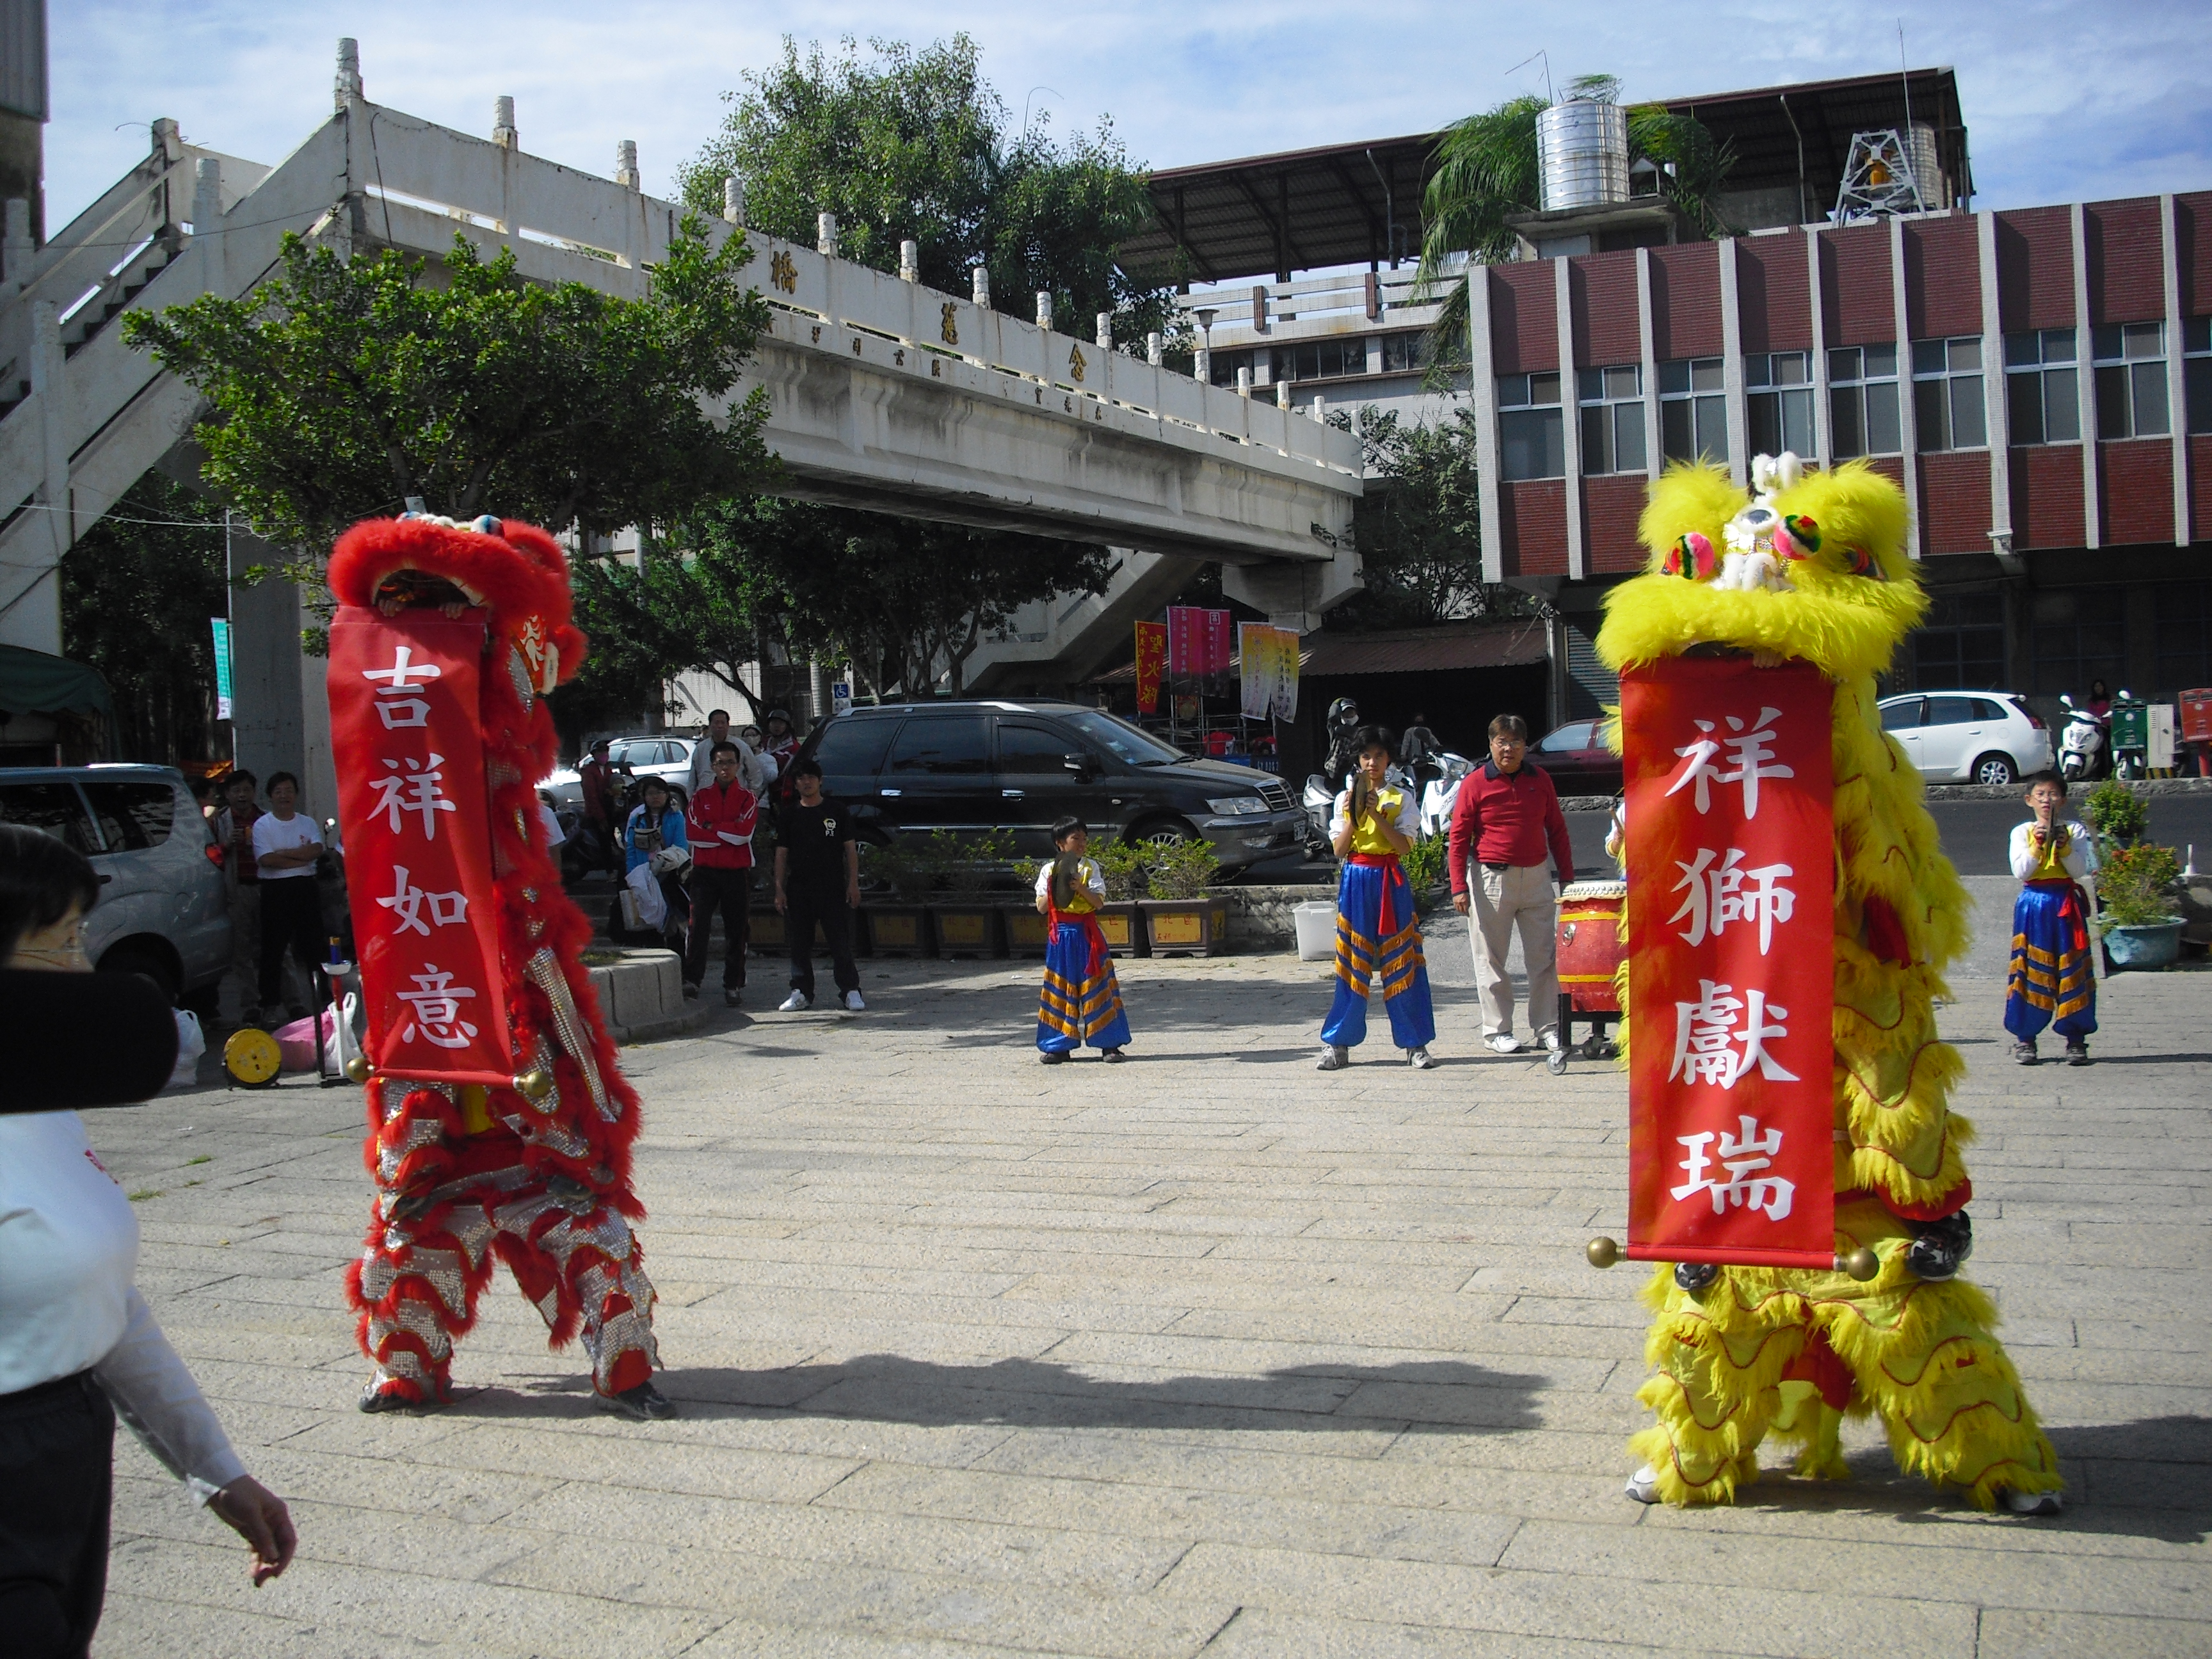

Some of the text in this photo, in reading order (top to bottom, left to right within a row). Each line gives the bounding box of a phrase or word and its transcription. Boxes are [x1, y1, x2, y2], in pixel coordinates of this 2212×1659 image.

[362, 646, 477, 1048] 吉祥如意
[1665, 706, 1800, 1222] 祥獅獻瑞
